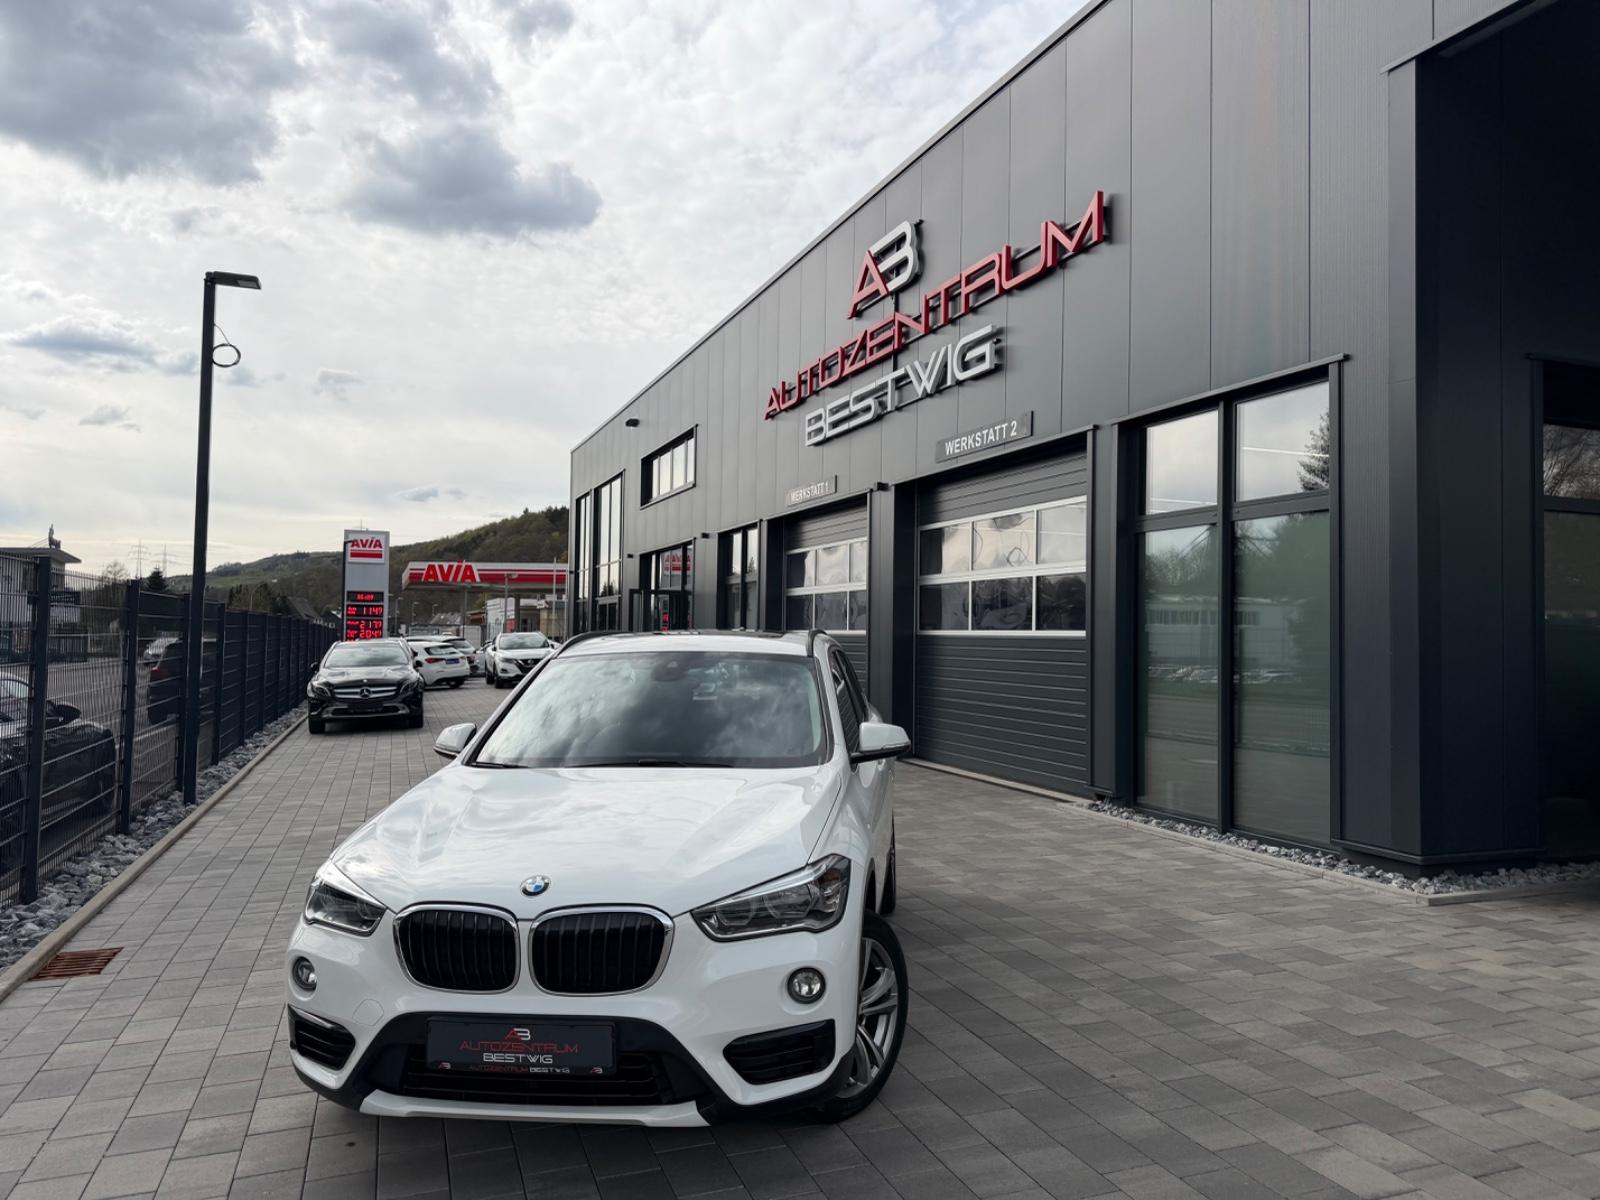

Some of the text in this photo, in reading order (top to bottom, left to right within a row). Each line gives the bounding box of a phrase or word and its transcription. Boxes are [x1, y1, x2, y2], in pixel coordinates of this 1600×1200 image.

[765, 190, 1105, 420] AUTOZENTRUM
[805, 325, 999, 447] BESTWIG
[945, 420, 1018, 456] WERKSTATT 2
[790, 483, 825, 502] WERKSTATT
[350, 536, 383, 549] AVIA
[422, 560, 479, 583] AVIA
[459, 1040, 579, 1054] AUTOZENTRUM
[483, 1052, 553, 1064] BESTWIG
